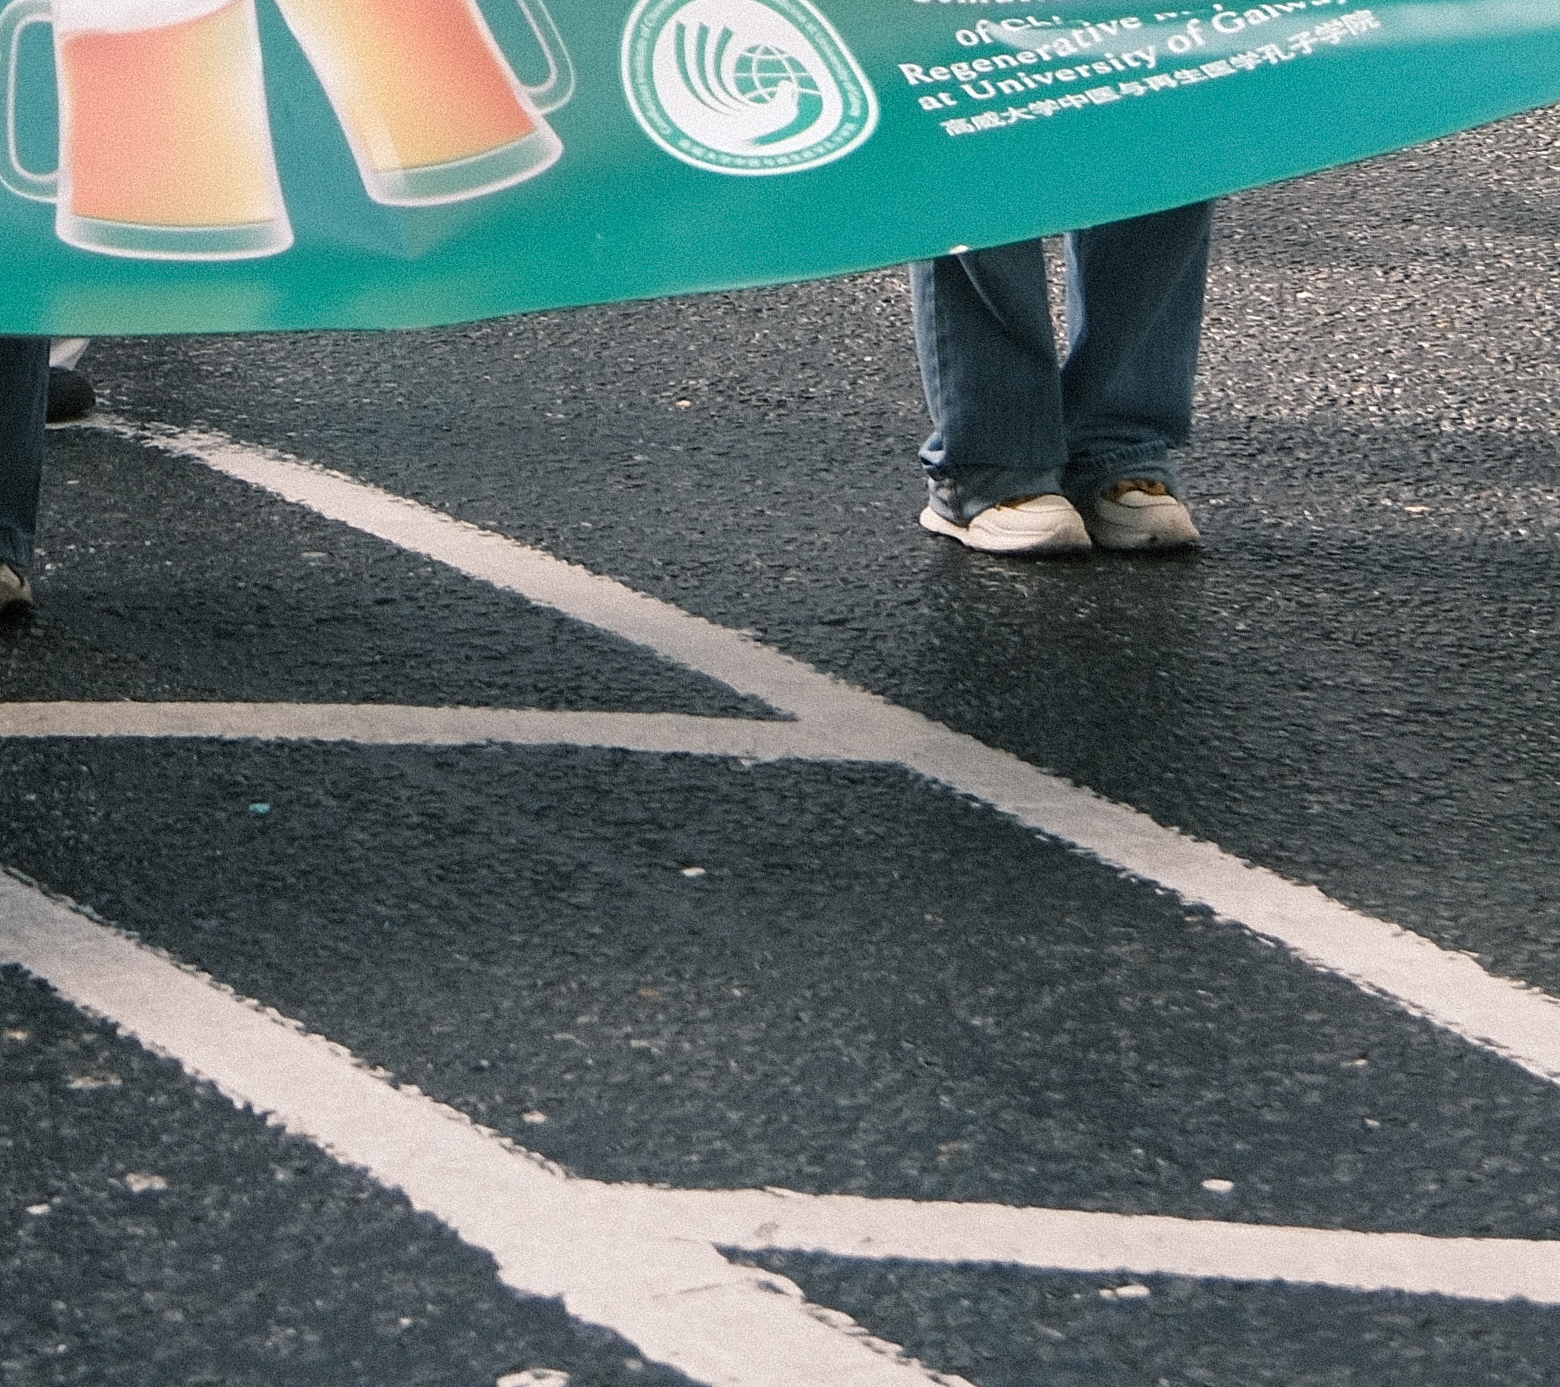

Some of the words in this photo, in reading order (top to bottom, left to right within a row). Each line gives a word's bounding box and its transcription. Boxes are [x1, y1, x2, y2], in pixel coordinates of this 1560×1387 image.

[897, 16, 1144, 86] Regenerative
[917, 92, 958, 111] at
[960, 45, 1158, 100] University
[1167, 18, 1207, 53] of
[955, 19, 994, 47] of
